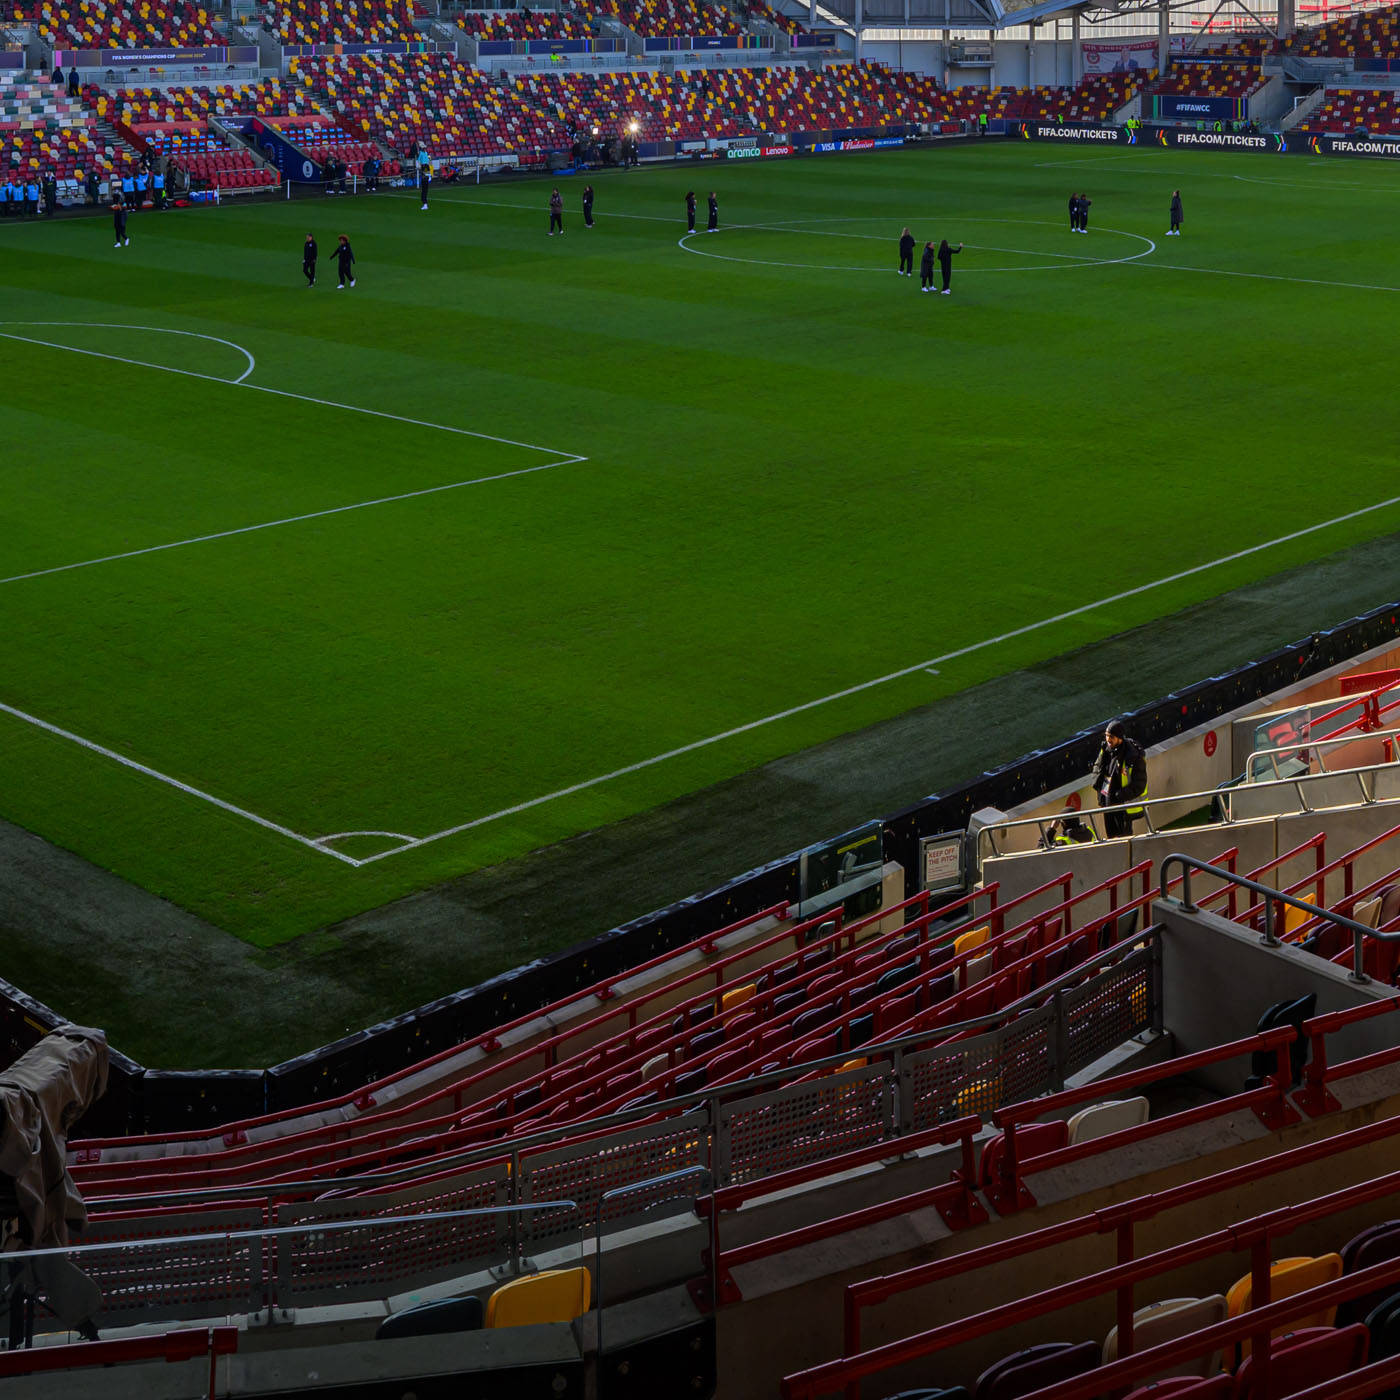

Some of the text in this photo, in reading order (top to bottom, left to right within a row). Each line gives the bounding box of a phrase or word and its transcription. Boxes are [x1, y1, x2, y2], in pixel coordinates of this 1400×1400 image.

[1176, 103, 1211, 113] #FIFAWCC
[1038, 127, 1118, 140] FIFA.COM/TICKETS
[844, 139, 874, 151] Budweiser
[1177, 133, 1266, 147] FIFA.COM/TICKETS
[765, 147, 788, 155] Lenovo
[821, 142, 836, 151] VISA
[727, 148, 760, 159] aramco
